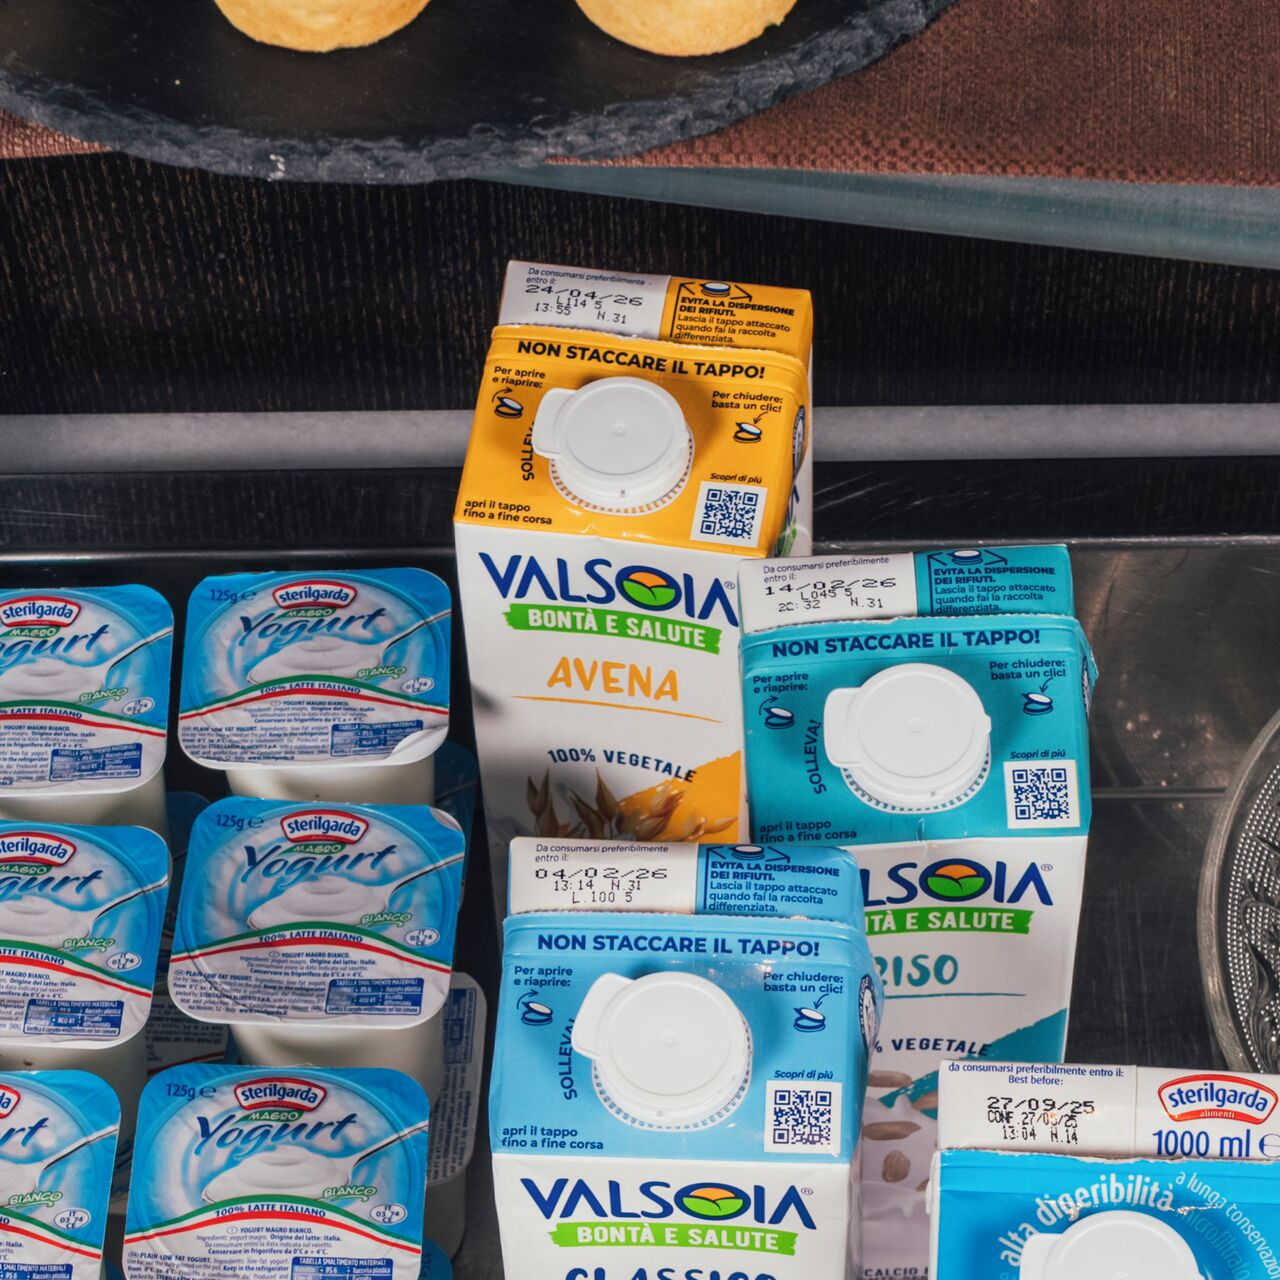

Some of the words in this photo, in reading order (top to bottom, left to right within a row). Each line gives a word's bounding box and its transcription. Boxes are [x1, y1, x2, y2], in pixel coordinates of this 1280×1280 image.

[525, 285, 644, 306] 24/04/26
[680, 296, 710, 306] EVITA
[712, 299, 726, 308] LA
[727, 301, 795, 316] DISPERSIONE
[535, 302, 571, 315] 13:55
[679, 305, 697, 314] DEI
[699, 308, 736, 318] RIFIUTI.
[518, 341, 562, 358] NON
[566, 347, 667, 372] STACCARE
[671, 360, 688, 375] IL
[693, 362, 765, 379] TAPPO!
[278, 586, 349, 603] sterilgarda
[478, 552, 739, 627] VALSOIA
[765, 578, 896, 595] 14/02/26
[2, 603, 74, 620] sterilgarda
[238, 607, 387, 651] Yogurt
[528, 608, 597, 631] BONTÀ
[606, 615, 618, 626] E
[626, 617, 706, 648] SALUTE
[773, 640, 821, 657] NON
[824, 632, 934, 654] STACCARE
[940, 631, 958, 648] IL
[963, 629, 1040, 646] TAPPO!
[547, 656, 679, 702] AVENA
[547, 748, 596, 763] 100%
[604, 750, 696, 783] VEGETALE
[804, 720, 827, 794] SOLLEVA!
[1010, 750, 1039, 759] Scopri
[287, 817, 361, 837] sterilgarda
[240, 844, 397, 887] Yogurt
[535, 868, 668, 880] 04/02/26
[553, 880, 594, 891] 13:14
[906, 912, 919, 929] E
[928, 912, 1014, 929] SALUTE
[538, 935, 587, 951] NON
[592, 935, 707, 954] STACCARE
[713, 940, 733, 955] IL
[740, 939, 820, 957] TAPPO!
[892, 1038, 992, 1057] VEGETALE
[948, 1062, 959, 1073] da
[962, 1063, 1013, 1074] consumarsi
[1015, 1063, 1087, 1077] preferibilmente
[1089, 1066, 1112, 1077] entro
[1114, 1067, 1124, 1078] il:
[1008, 1075, 1028, 1085] Best
[1030, 1076, 1064, 1086] before:
[241, 1082, 319, 1104] sterilgarda
[1167, 1082, 1269, 1113] sterilgarda
[987, 1096, 1095, 1115] 27/09/25
[1200, 1109, 1236, 1120] alimenti
[194, 1113, 358, 1159] Yogurt
[1153, 1130, 1210, 1158] 1000
[1219, 1129, 1251, 1158] ml
[1175, 1172, 1185, 1185] a
[1188, 1172, 1228, 1209] lunga
[520, 1177, 817, 1231] VALSOIA
[999, 1220, 1040, 1268] alta
[1036, 1174, 1173, 1227] digeribilità
[577, 1224, 655, 1244] BONTÀ
[665, 1228, 678, 1244] E
[688, 1229, 779, 1250] SALUTE
